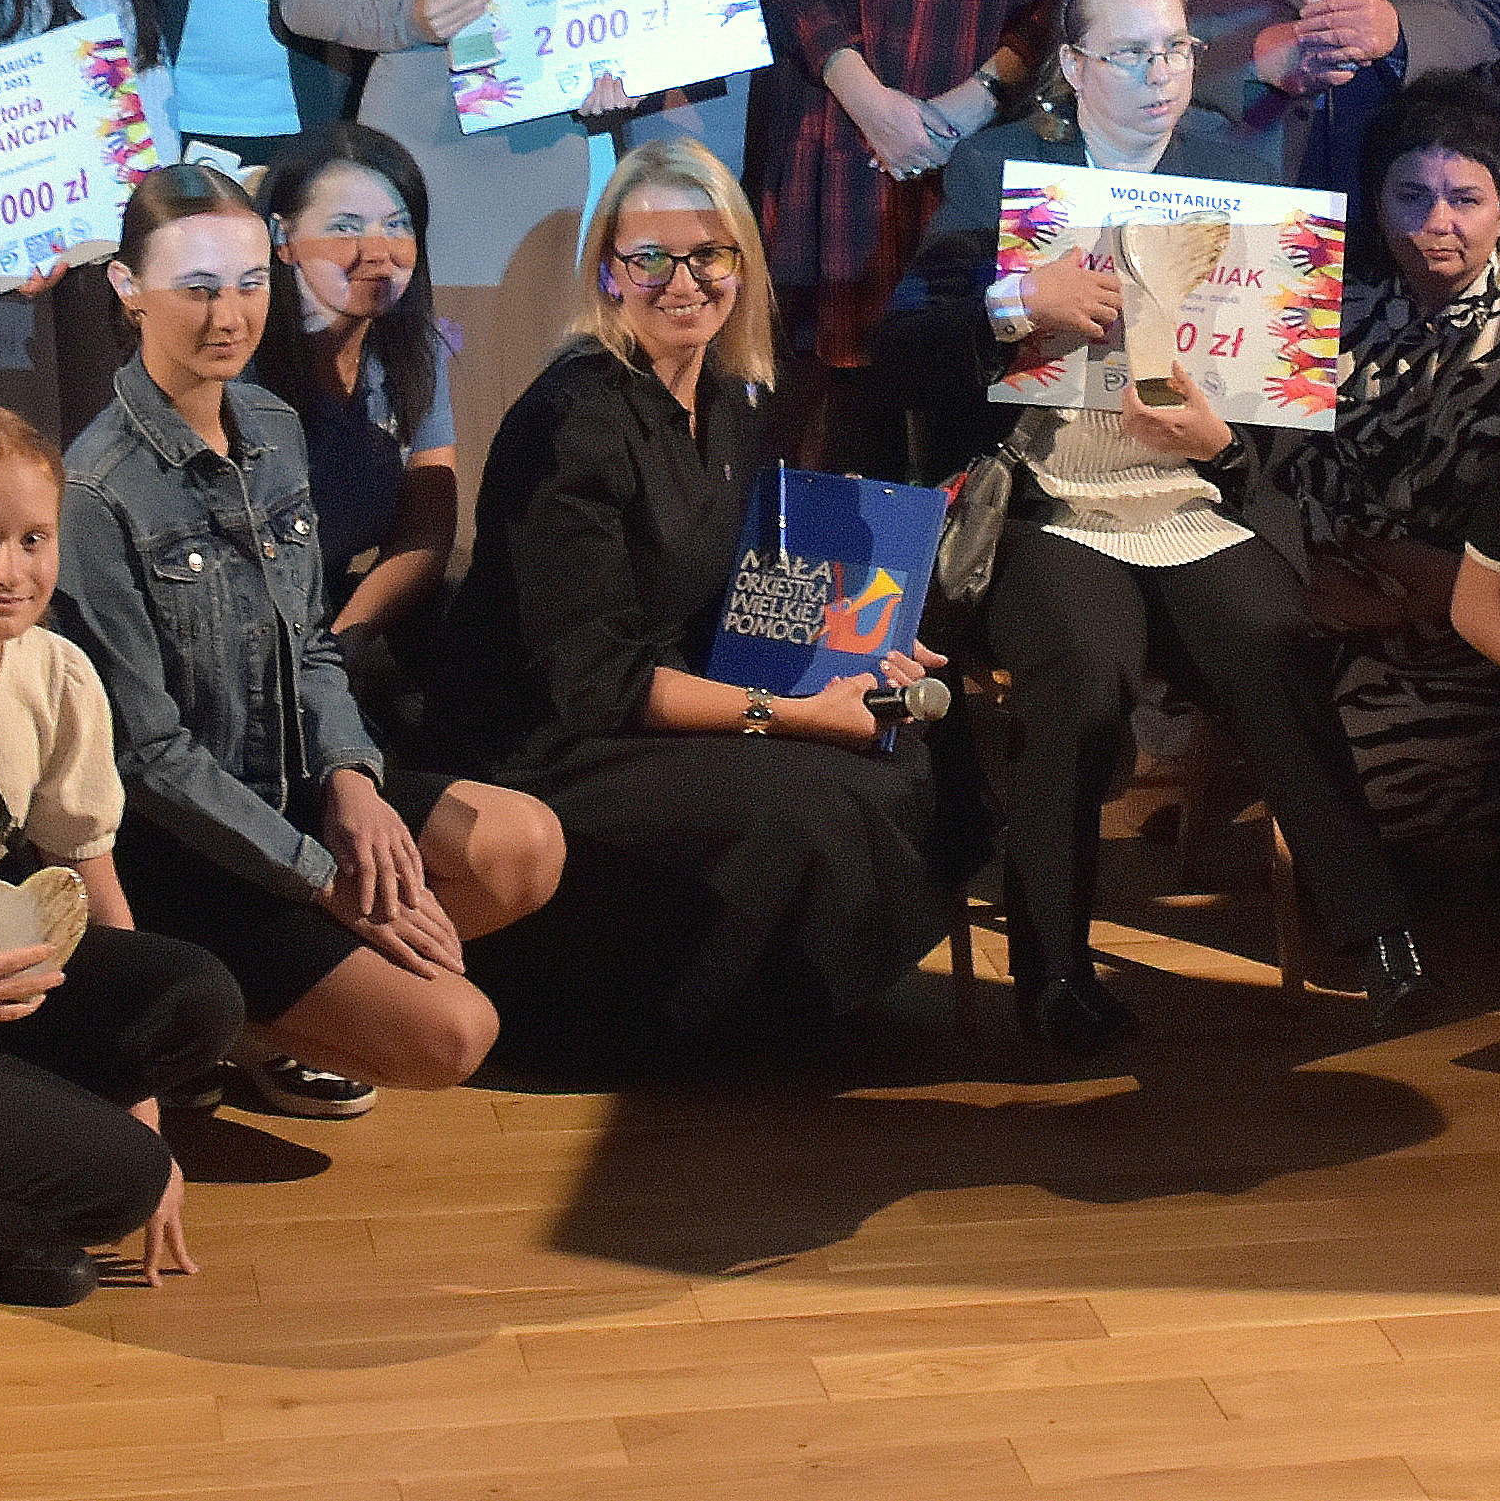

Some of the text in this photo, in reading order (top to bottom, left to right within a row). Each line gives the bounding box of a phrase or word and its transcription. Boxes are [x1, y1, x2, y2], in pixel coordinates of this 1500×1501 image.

[534, 25, 554, 57] 2
[565, 8, 629, 50] 000
[3, 73, 32, 92] 2023
[0, 181, 56, 226] 000
[63, 167, 90, 206] zł
[1110, 186, 1242, 213] WOLONTARIUSZ
[1208, 327, 1246, 358] zł
[734, 570, 828, 604] ORKIESTRA
[730, 590, 825, 625] WIELKIEJ
[723, 610, 820, 646] POMOCY
